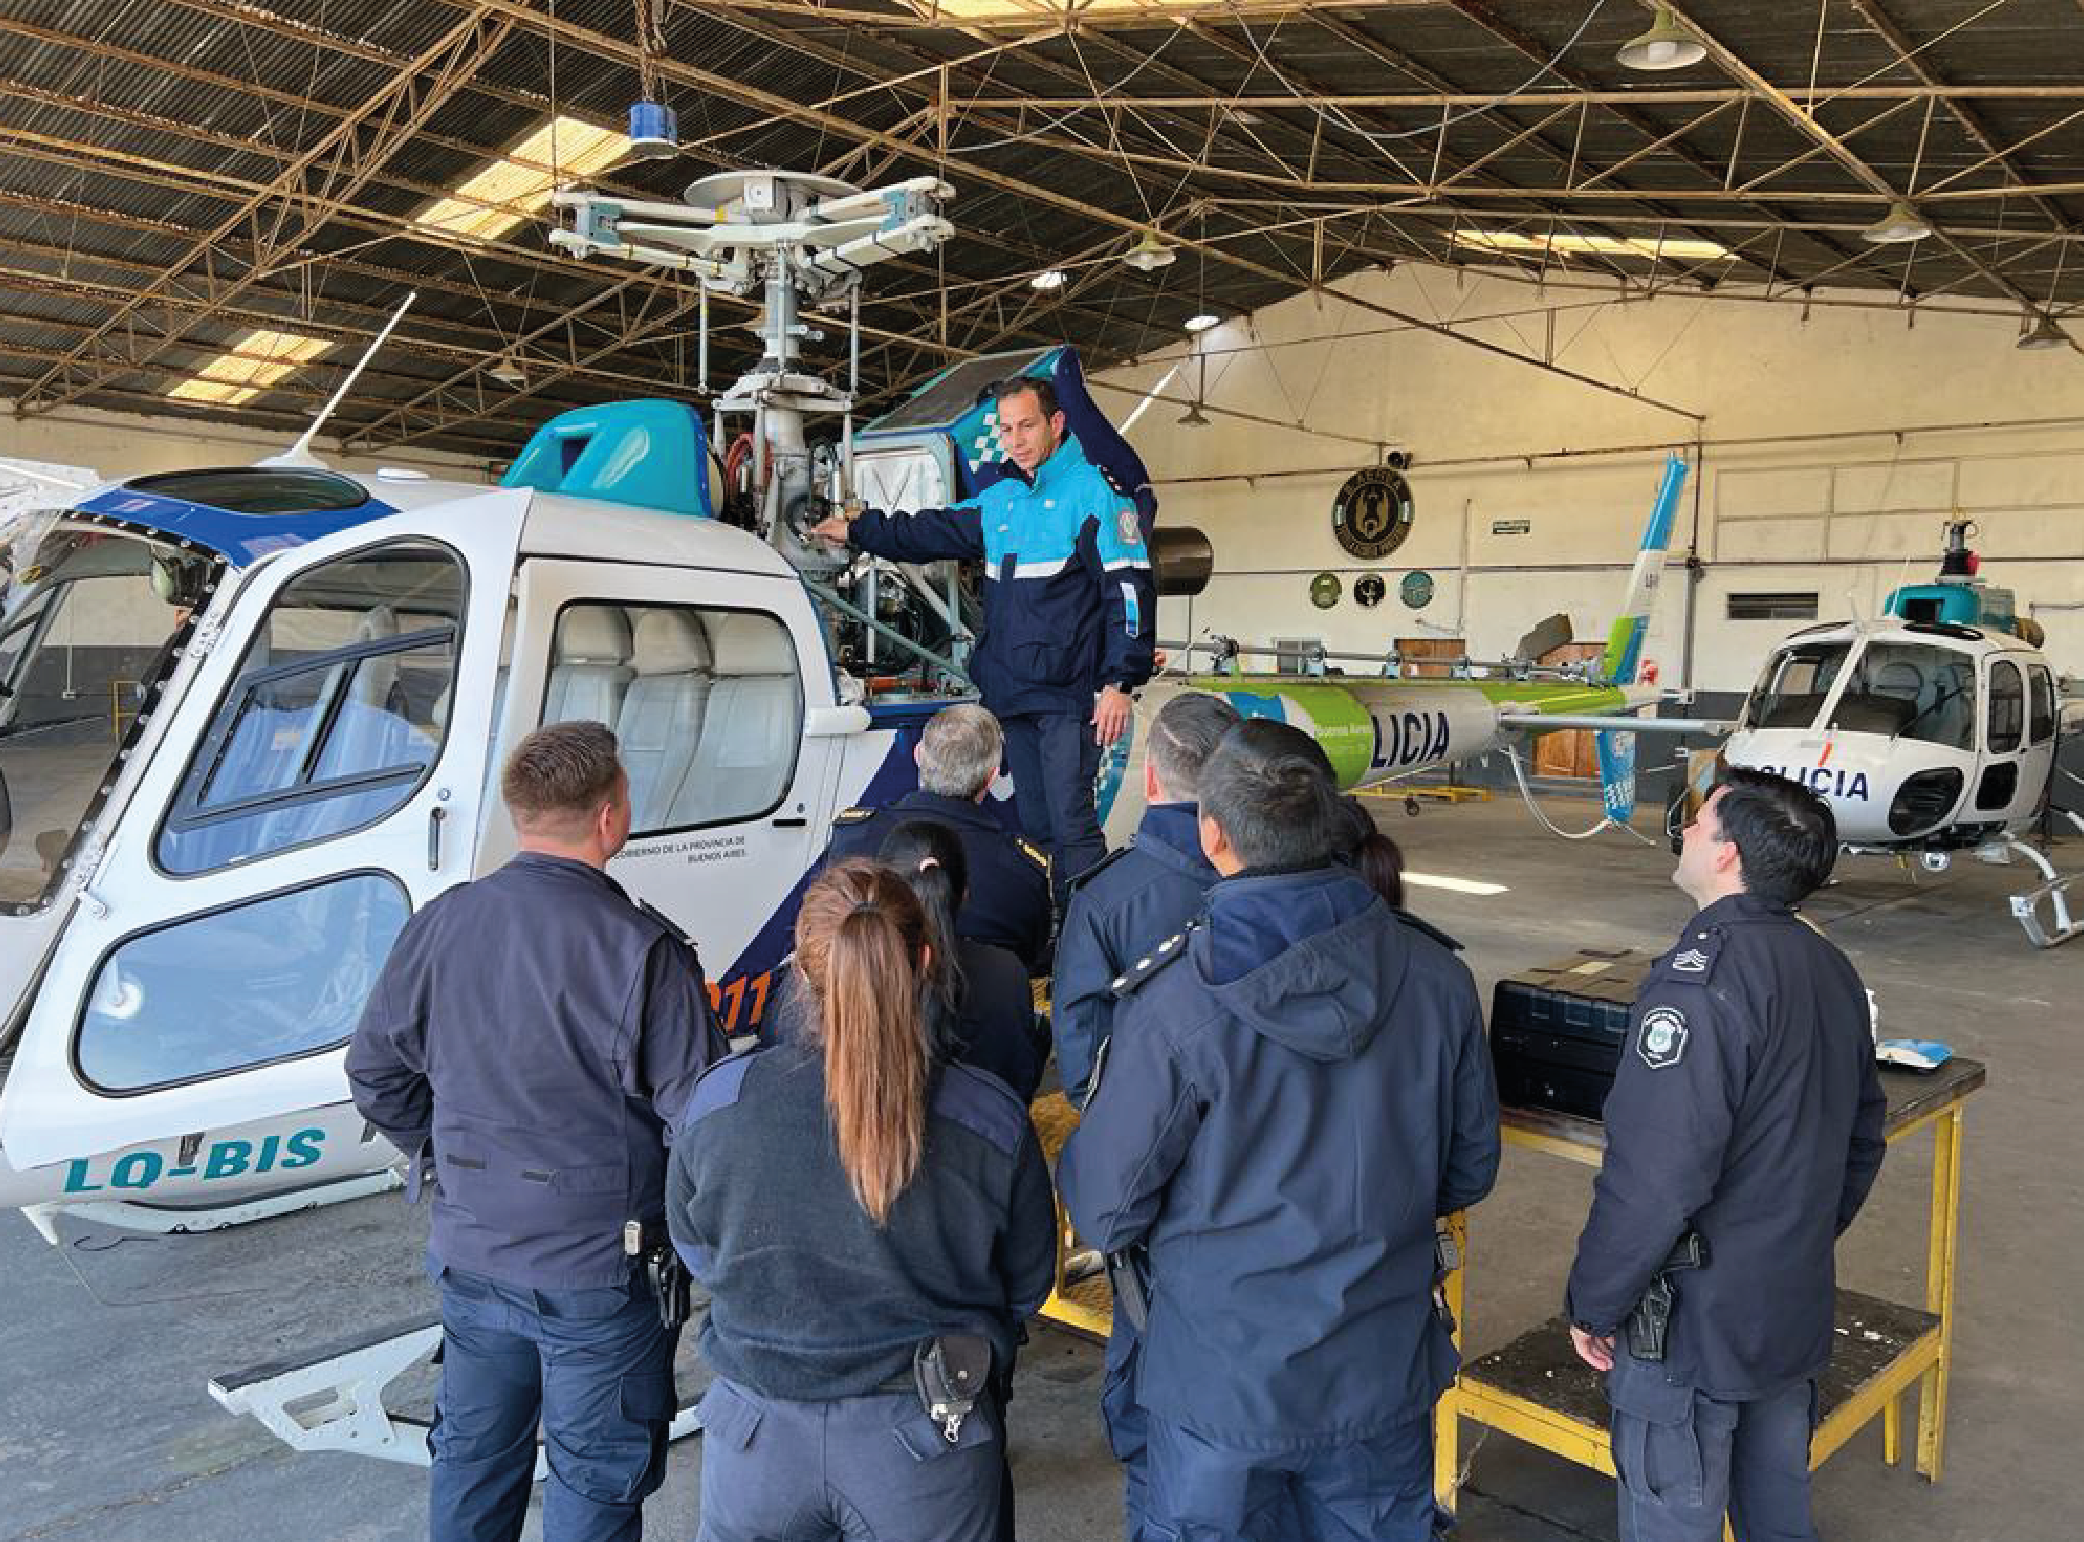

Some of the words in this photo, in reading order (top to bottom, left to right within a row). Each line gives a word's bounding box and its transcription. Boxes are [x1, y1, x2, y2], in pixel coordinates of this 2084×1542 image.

[663, 845, 673, 853] DE
[677, 844, 688, 852] LA
[690, 838, 734, 851] PROVINCIA
[736, 836, 744, 845] DE
[688, 851, 721, 863] BUENOS
[723, 848, 744, 857] AIRES
